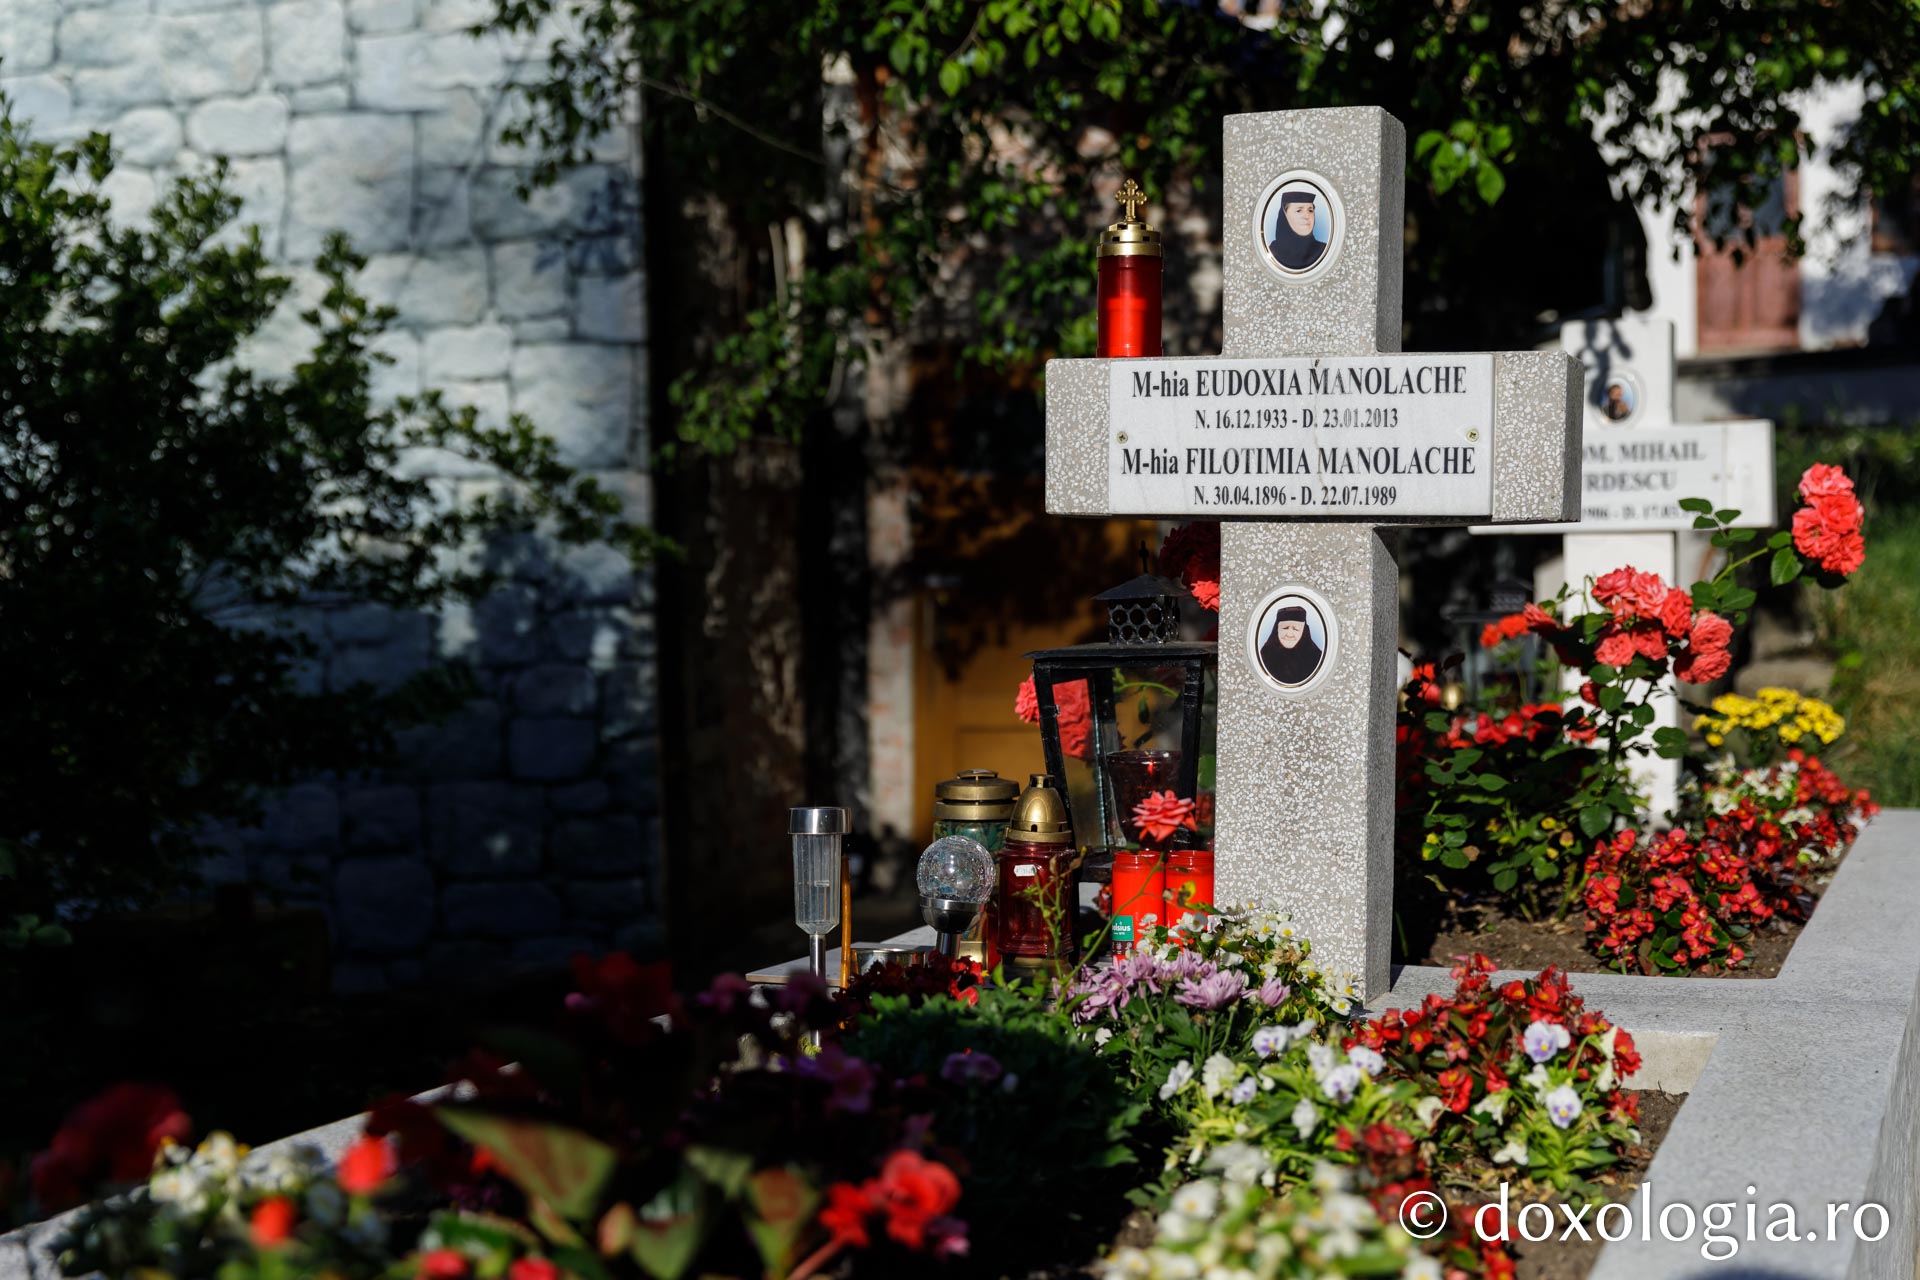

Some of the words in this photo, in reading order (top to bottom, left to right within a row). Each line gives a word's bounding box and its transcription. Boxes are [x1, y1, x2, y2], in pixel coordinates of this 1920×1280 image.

[1132, 370, 1189, 397] M-hia
[1195, 368, 1303, 397] EUDOXIA
[1309, 366, 1467, 395] MANOLACHE
[1195, 409, 1211, 429] N.
[1215, 408, 1288, 429] 16.12.1933
[1302, 408, 1318, 429] D.
[1323, 407, 1398, 428] 23.01.2013
[1121, 448, 1179, 475] M-hia
[1185, 447, 1311, 475] FILOTIMIA
[1316, 446, 1476, 475] MANOLACHE
[1194, 486, 1209, 505] N.
[1213, 485, 1287, 506] 30.04.1896
[1301, 485, 1316, 506] D.
[1321, 485, 1397, 506] 22.07.1989
